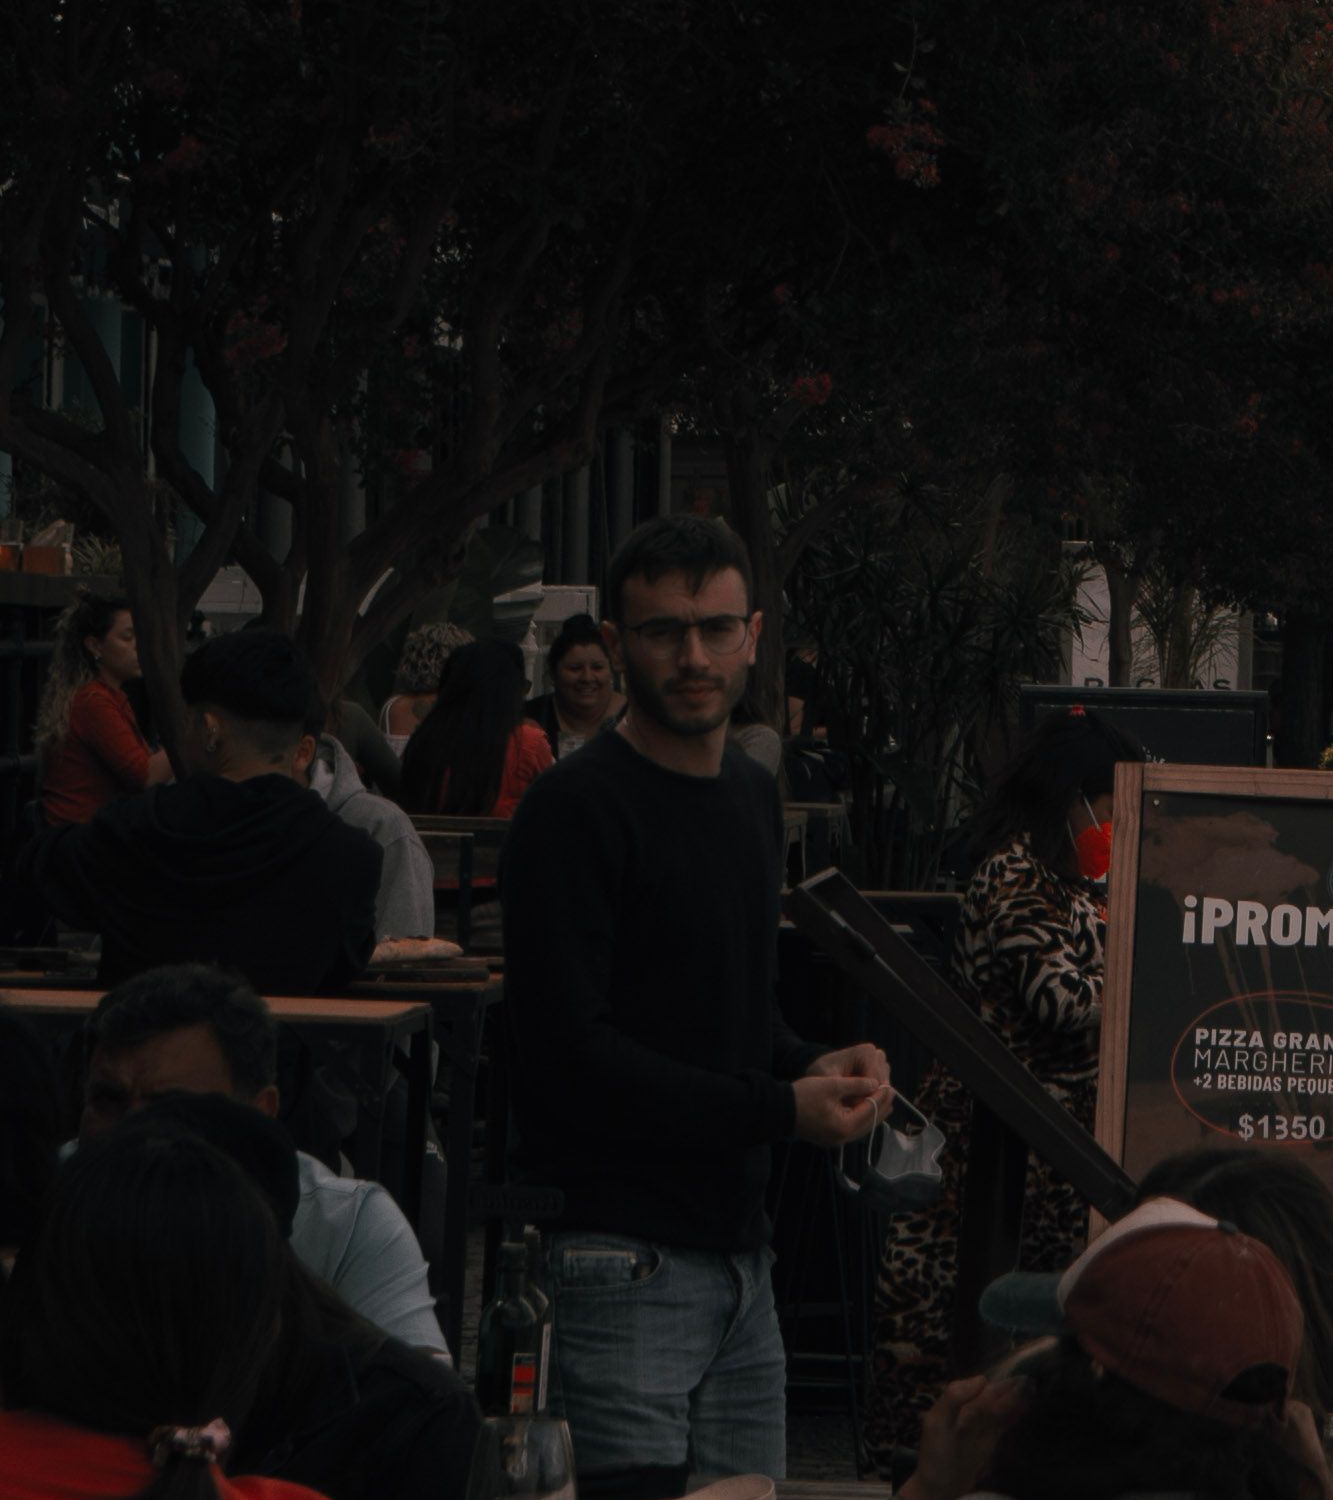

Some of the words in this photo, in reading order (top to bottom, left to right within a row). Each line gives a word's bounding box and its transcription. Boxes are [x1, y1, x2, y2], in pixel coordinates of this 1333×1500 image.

[1194, 1028, 1265, 1048] PIZZA
[1193, 1073, 1212, 1089] +2
[1216, 1073, 1282, 1093] BEBIDAS
[1238, 1113, 1326, 1141] $1350
